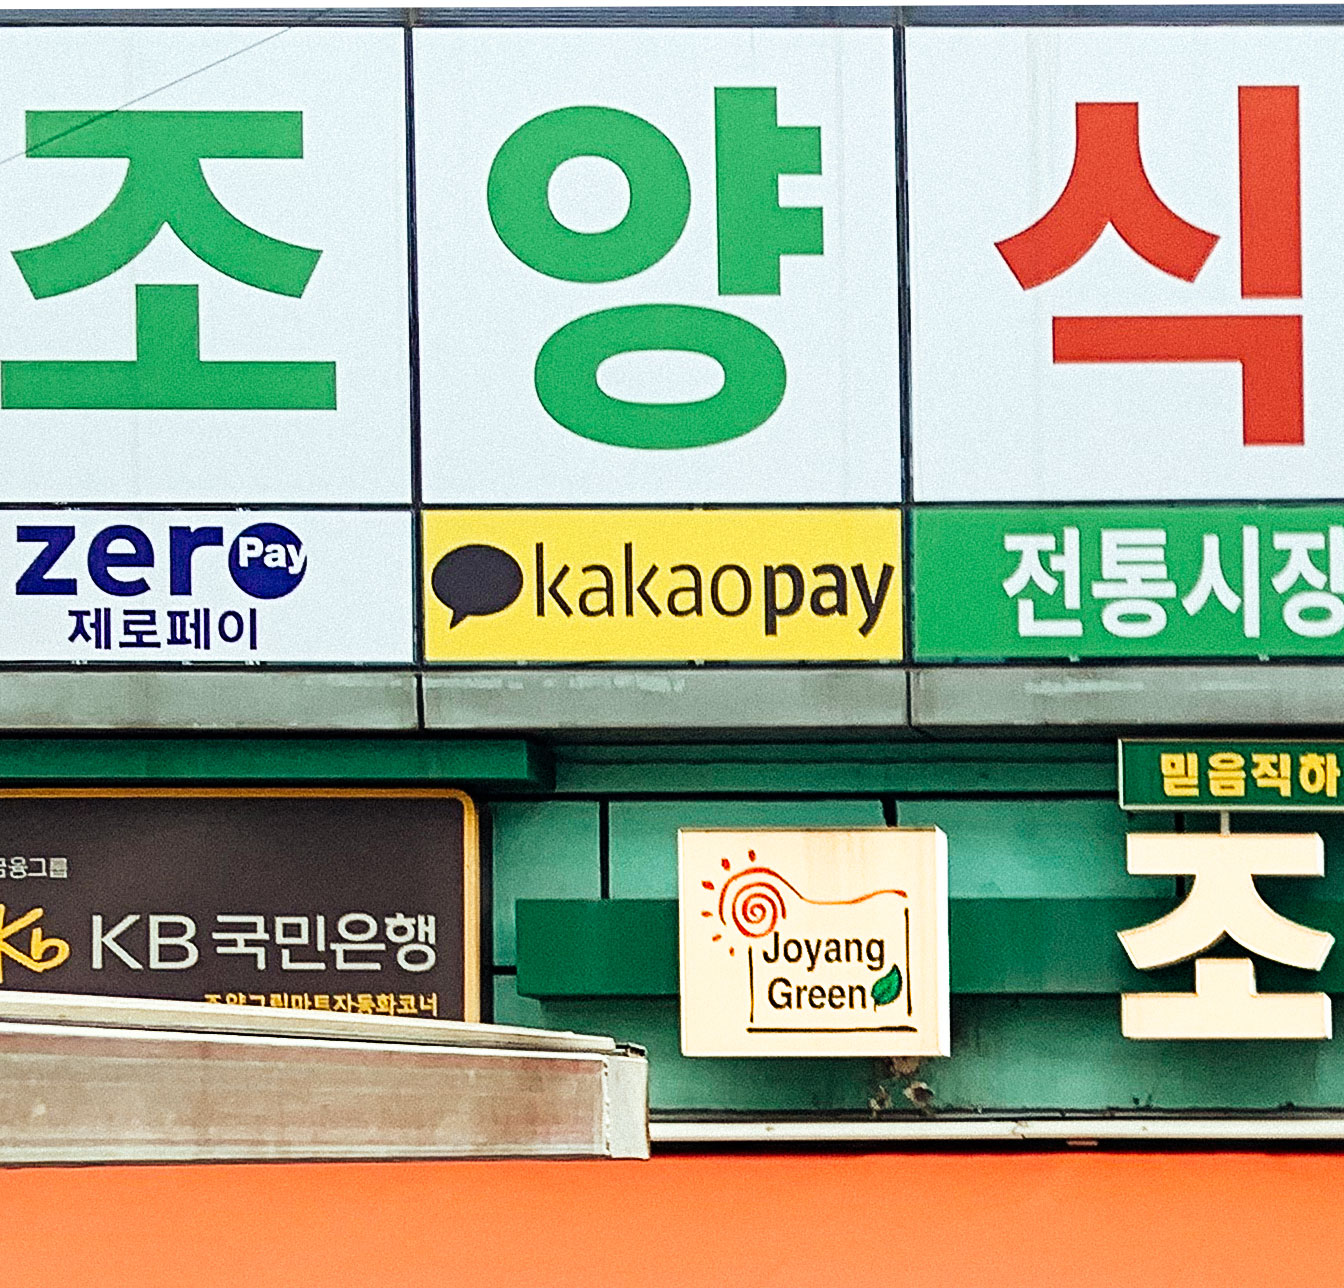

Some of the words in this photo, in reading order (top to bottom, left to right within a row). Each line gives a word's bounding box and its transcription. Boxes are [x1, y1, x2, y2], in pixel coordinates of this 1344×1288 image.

[535, 543, 893, 635] kakaopay
[68, 608, 258, 650] 제로페이
[762, 931, 886, 974] Joyang
[768, 979, 867, 1011] Green
